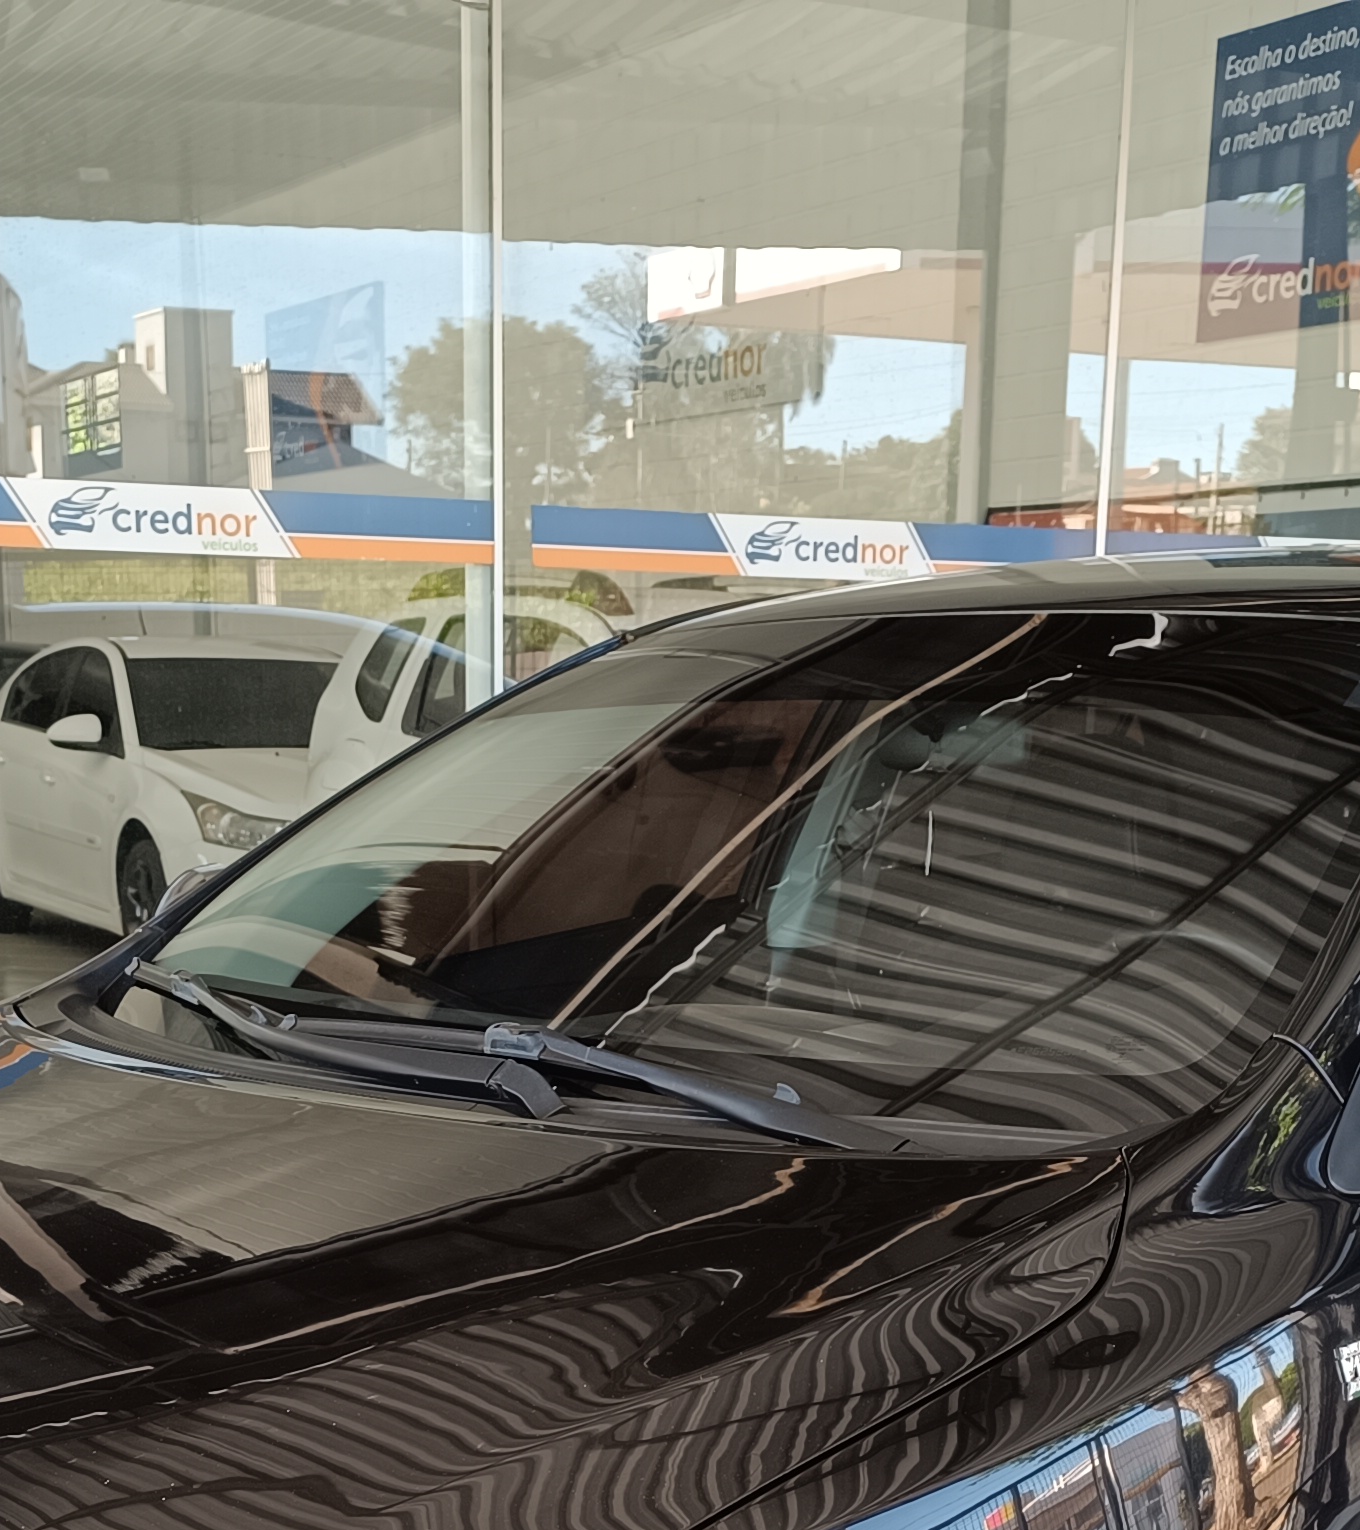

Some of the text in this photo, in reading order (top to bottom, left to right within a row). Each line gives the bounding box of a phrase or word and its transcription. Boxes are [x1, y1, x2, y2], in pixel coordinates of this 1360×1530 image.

[1225, 26, 1360, 81] Escolha o destino,
[1221, 70, 1341, 119] nós garantimos
[1219, 100, 1355, 156] a melhor direção!
[112, 503, 257, 537] crednor
[202, 537, 259, 553] veículos
[794, 534, 909, 565] crednor
